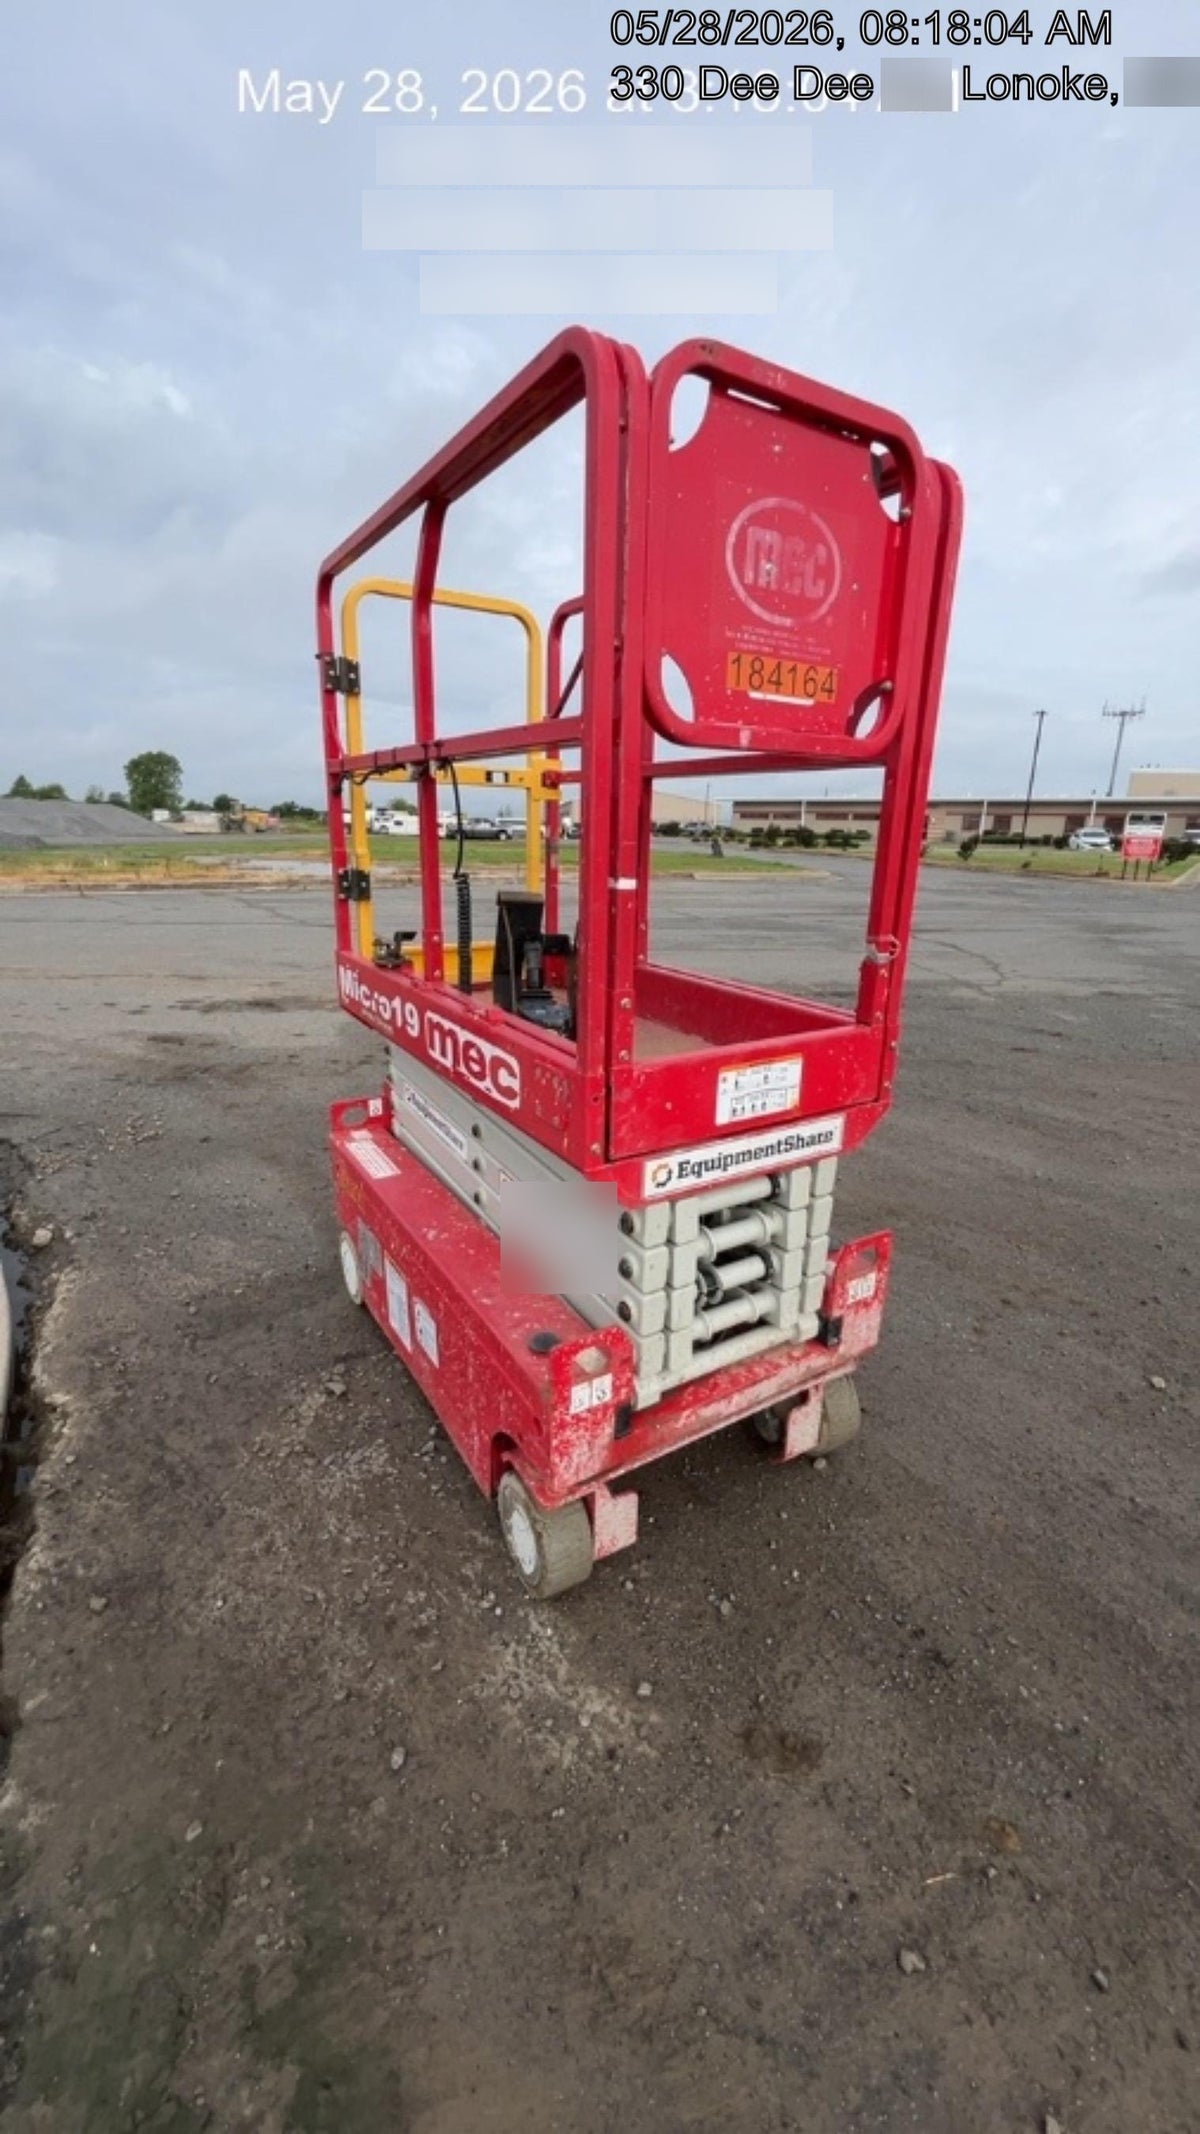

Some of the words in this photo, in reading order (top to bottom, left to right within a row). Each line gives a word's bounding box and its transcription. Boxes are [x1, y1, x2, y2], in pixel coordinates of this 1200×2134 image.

[731, 653, 834, 700] 184164
[425, 1010, 520, 1109] mec
[676, 1129, 834, 1180] EquipmentShare
